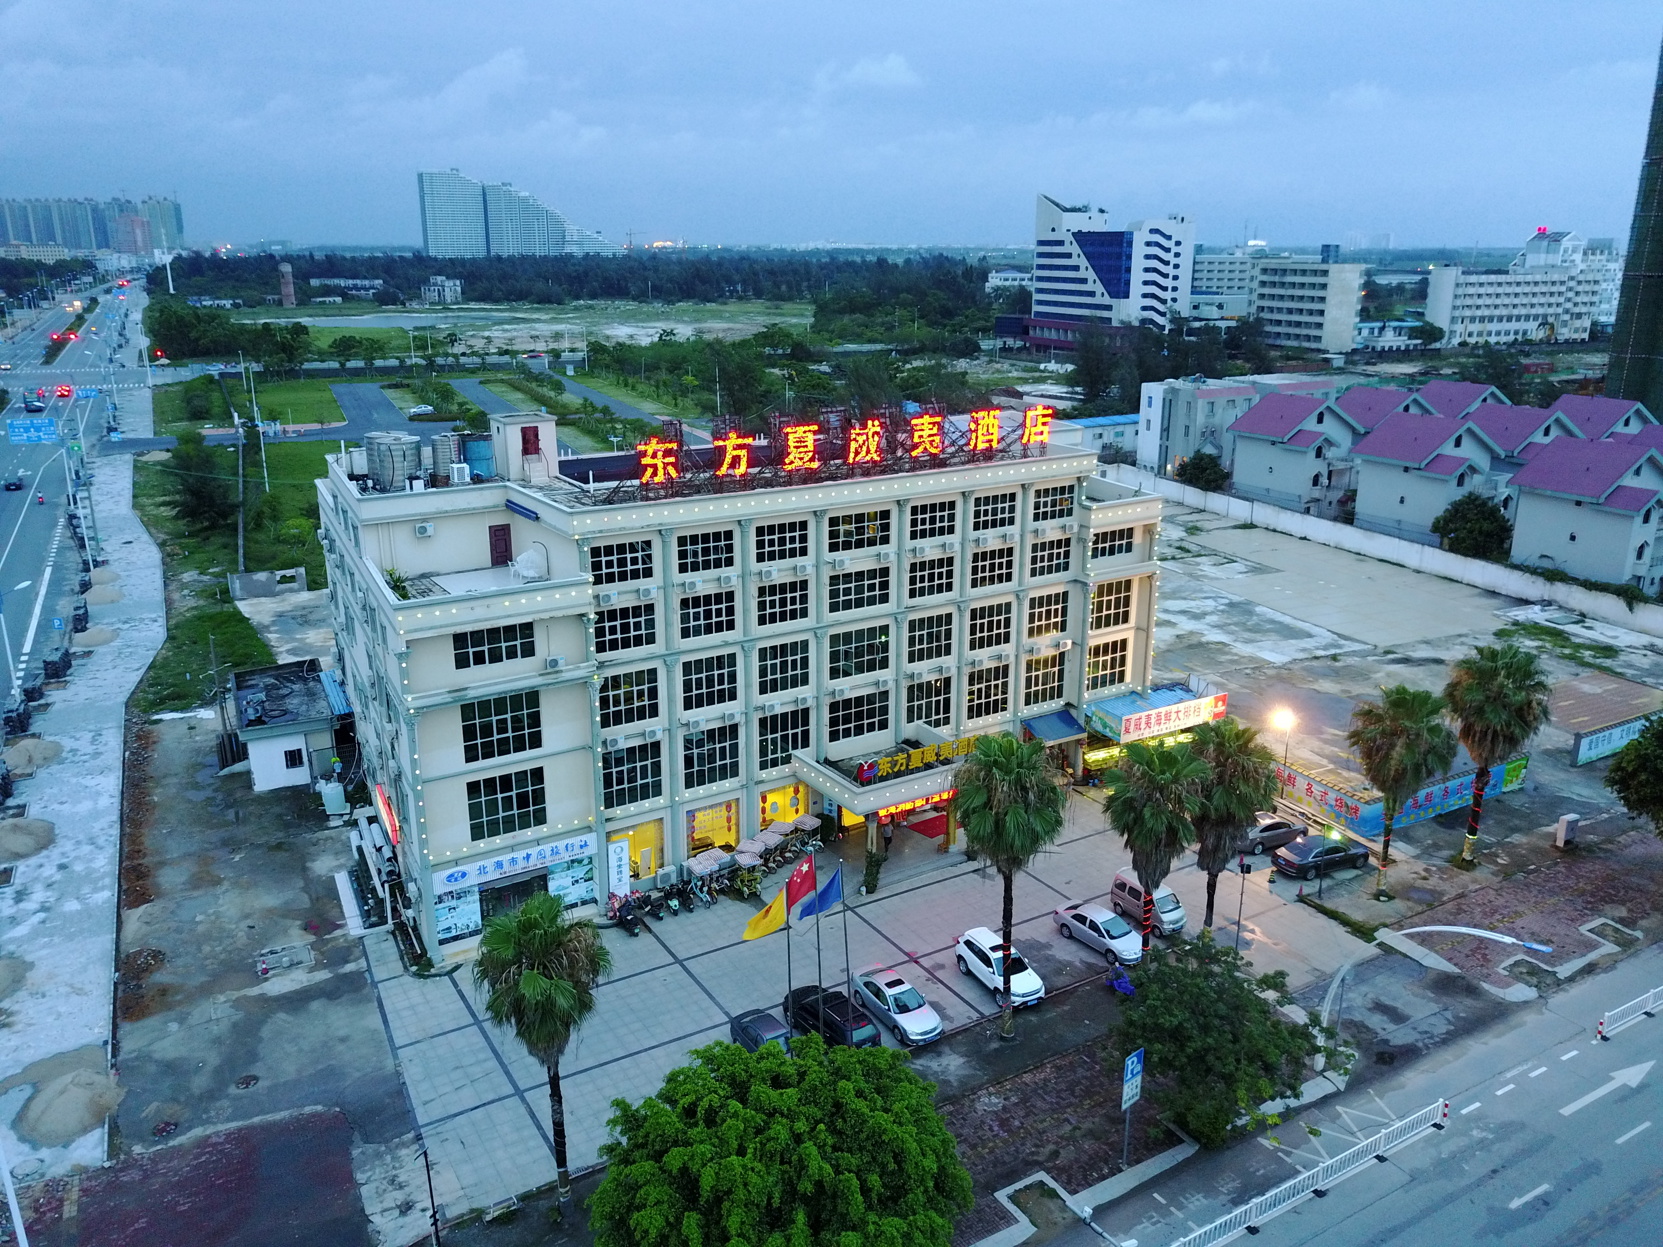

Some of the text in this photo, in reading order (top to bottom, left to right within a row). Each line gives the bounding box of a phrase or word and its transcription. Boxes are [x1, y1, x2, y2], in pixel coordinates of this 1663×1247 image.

[636, 404, 1054, 484] 东方夏威夷酒店
[1123, 702, 1202, 735] 夏威夷海鲜大排档
[477, 838, 590, 876] 北海市中国旅行社
[1126, 1057, 1137, 1080] P
